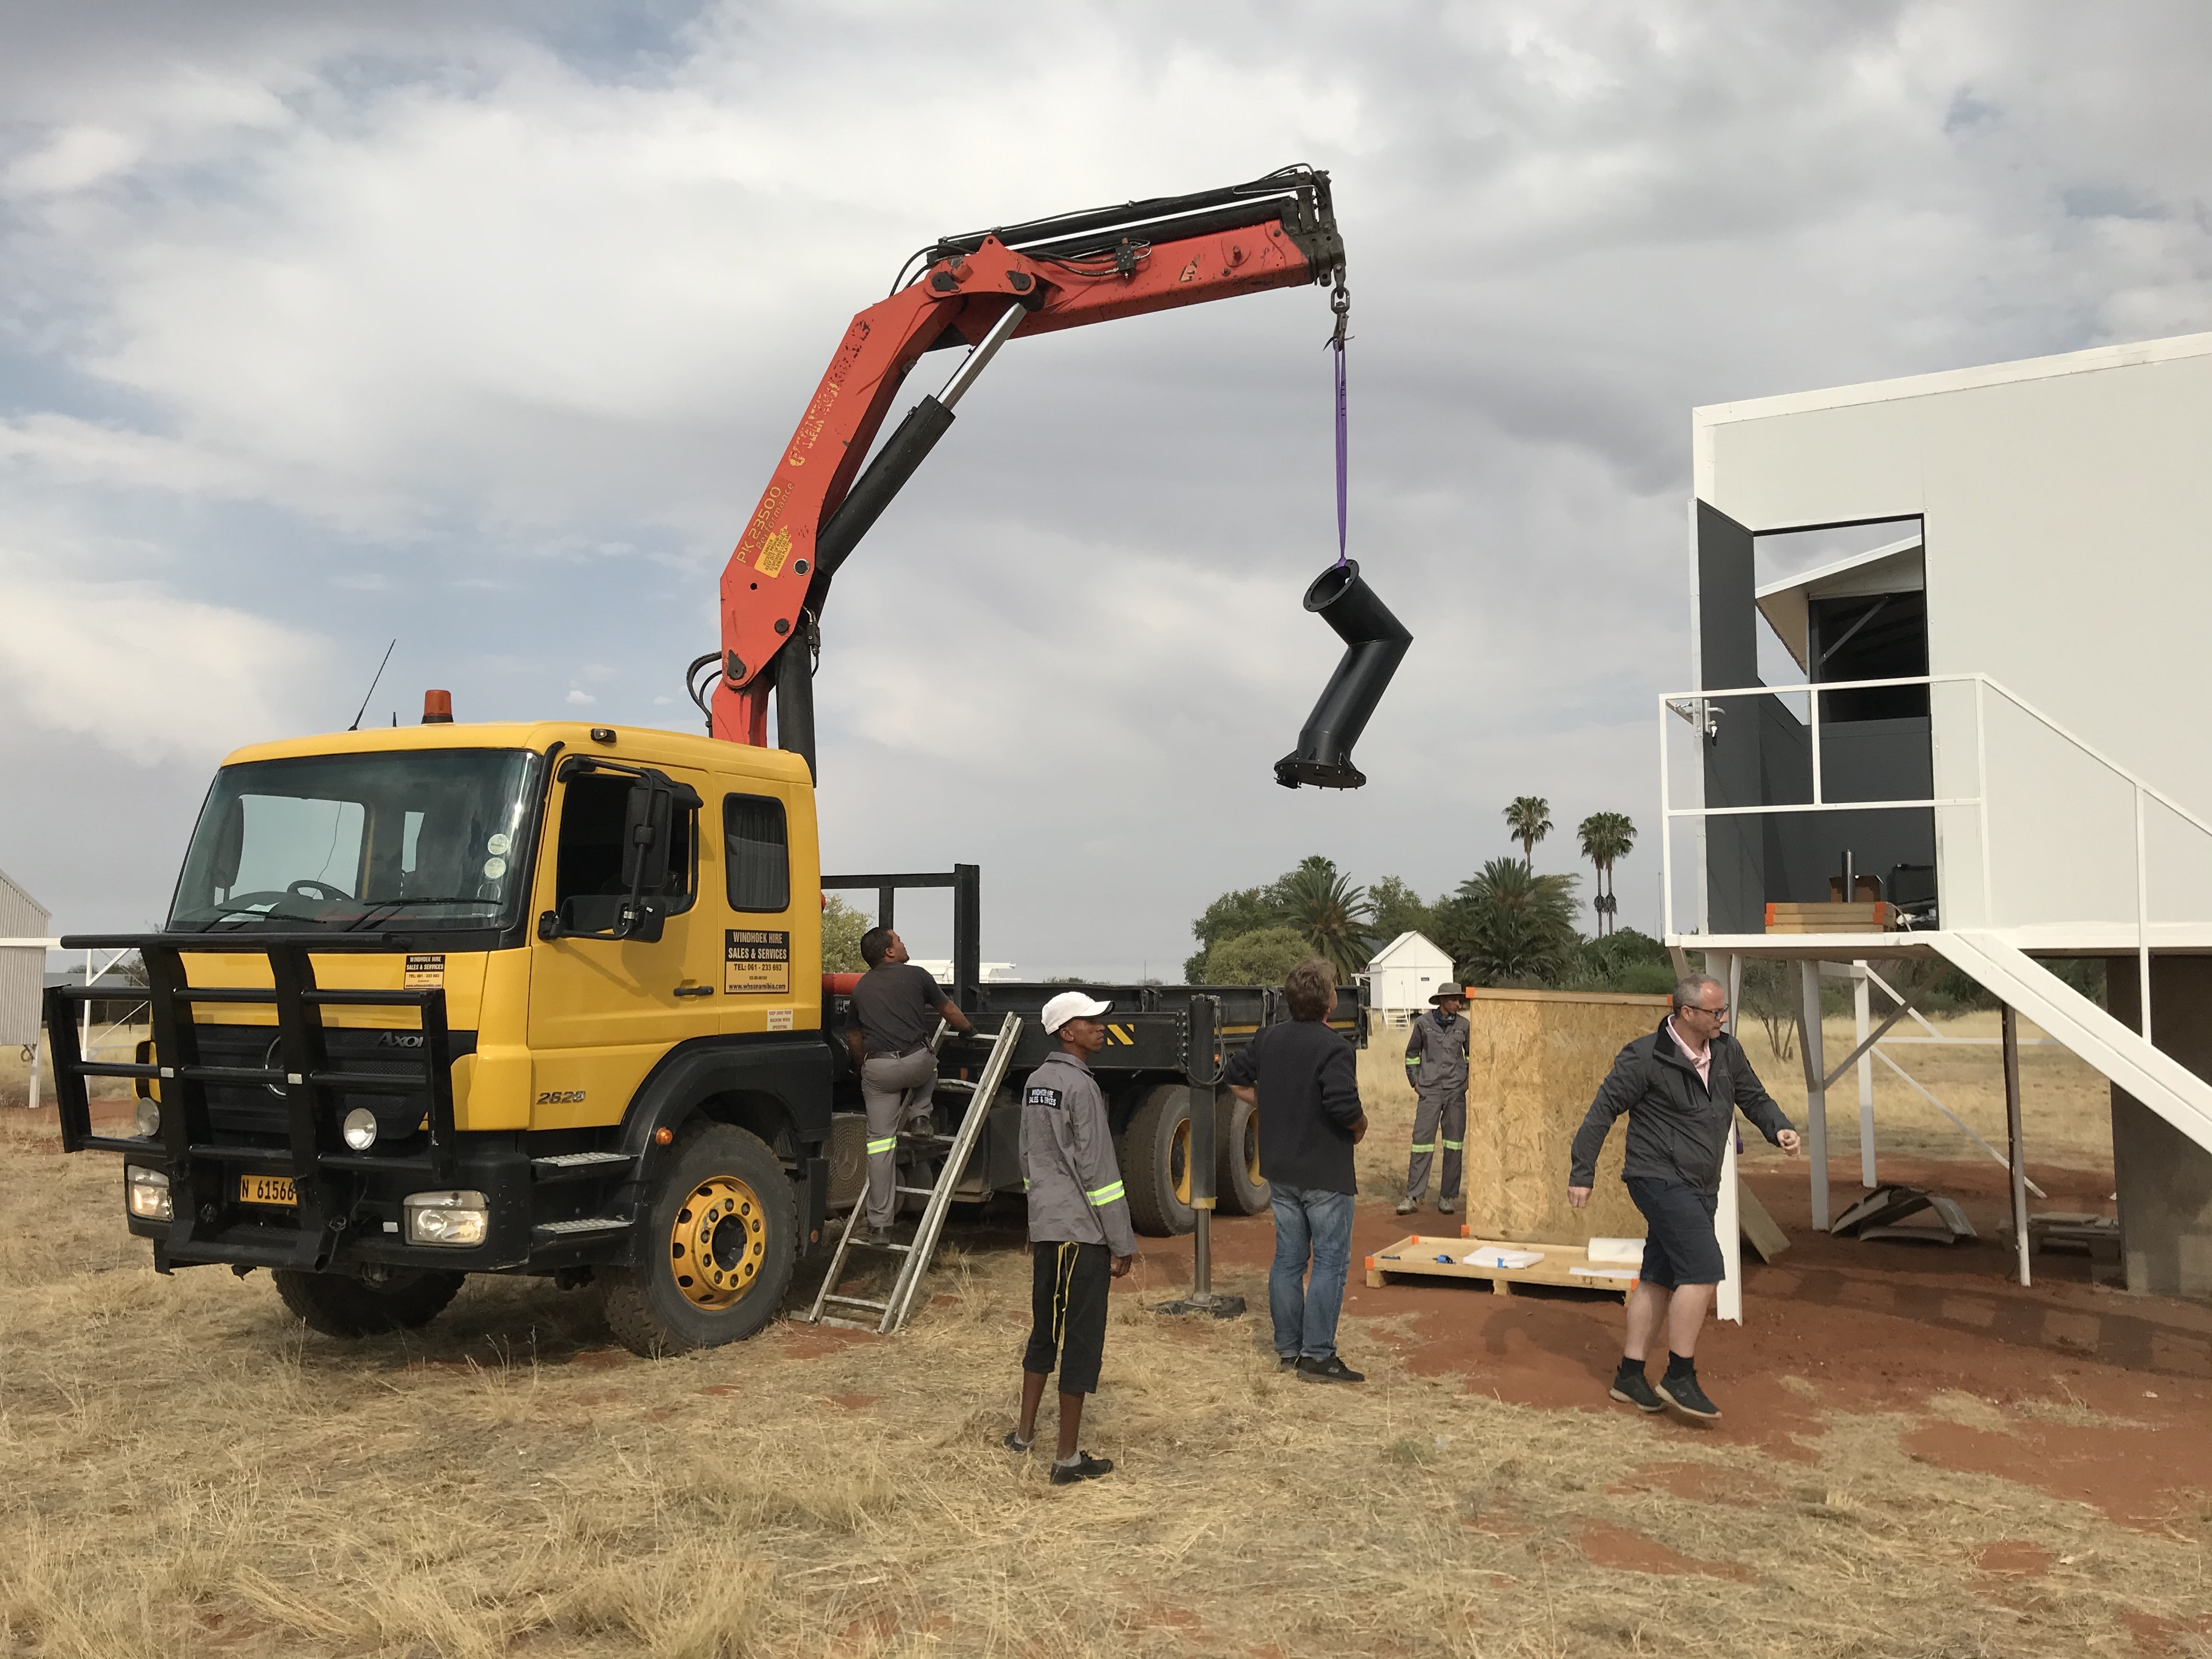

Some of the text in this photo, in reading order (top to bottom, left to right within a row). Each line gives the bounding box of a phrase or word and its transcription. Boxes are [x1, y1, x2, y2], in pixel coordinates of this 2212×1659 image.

[756, 483, 794, 549] Performance
[736, 487, 781, 563] PK 23500
[763, 539, 773, 555] DANGER
[733, 932, 782, 944] WINDHOEK HIRE
[729, 947, 787, 960] SALES & SERVICES
[536, 1091, 586, 1105] 2628
[242, 1180, 294, 1200] N 61566
